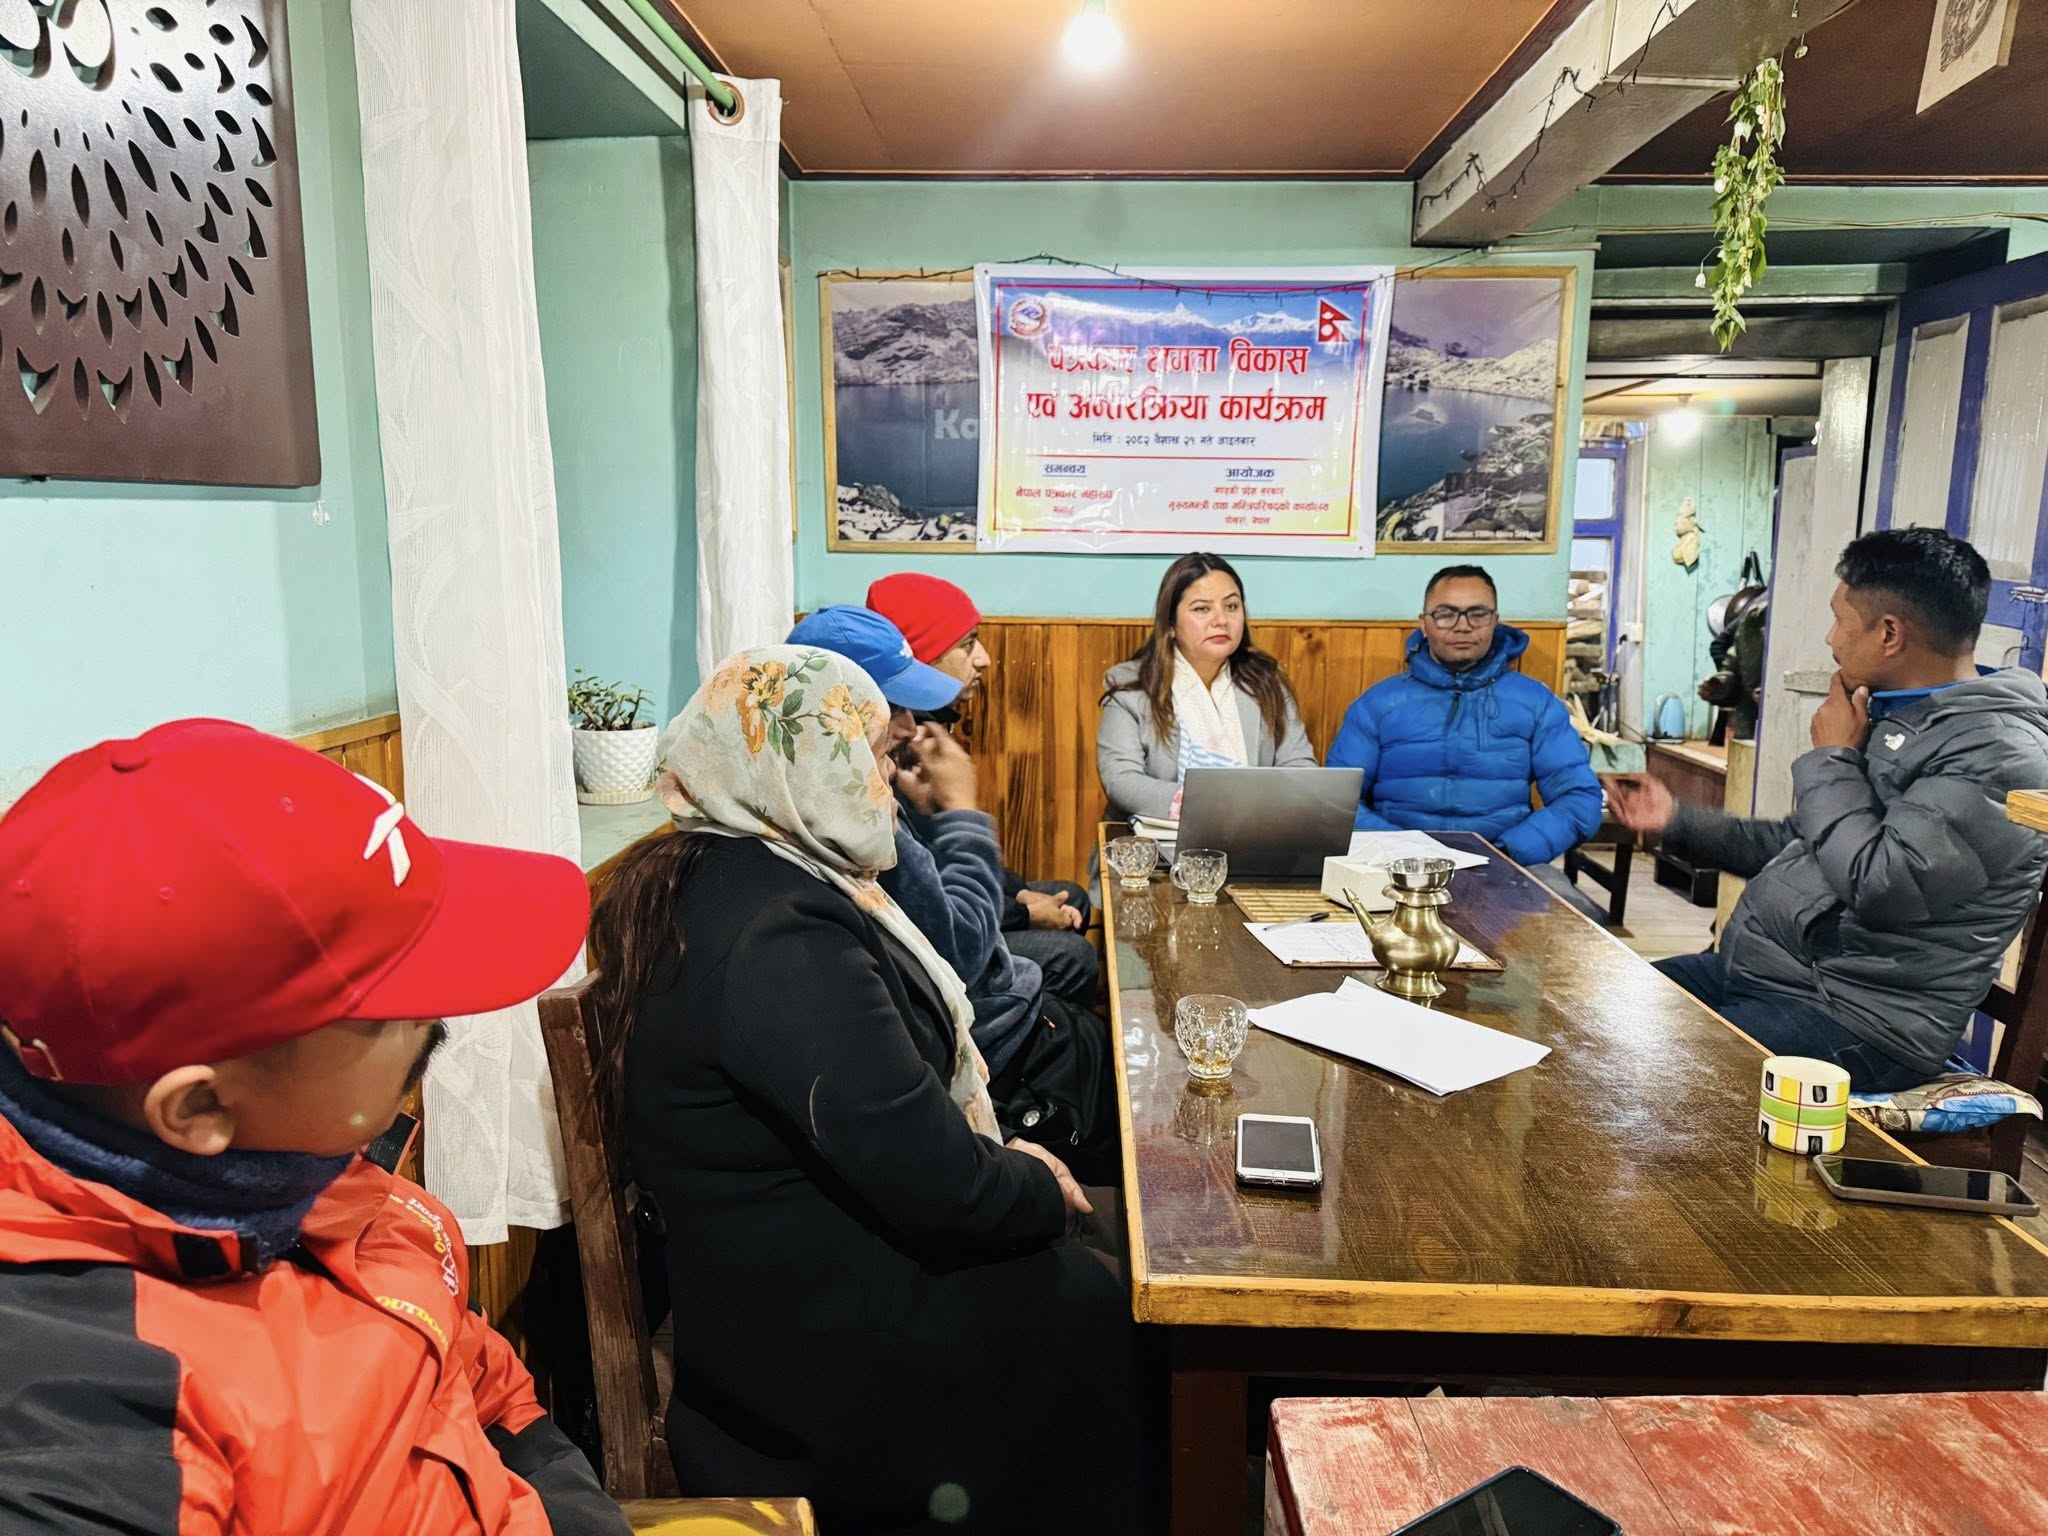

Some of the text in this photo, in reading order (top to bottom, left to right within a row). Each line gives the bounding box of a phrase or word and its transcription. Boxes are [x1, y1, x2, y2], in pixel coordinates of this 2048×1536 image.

[1231, 338, 1310, 375] विकास
[1220, 388, 1327, 422] कार्यक्रम
[1092, 432, 1112, 443] मिति
[1126, 435, 1150, 446] २०८२
[1044, 464, 1086, 473] समन्वय
[1225, 466, 1275, 478] आयोजक
[1015, 486, 1041, 498] नेपाल
